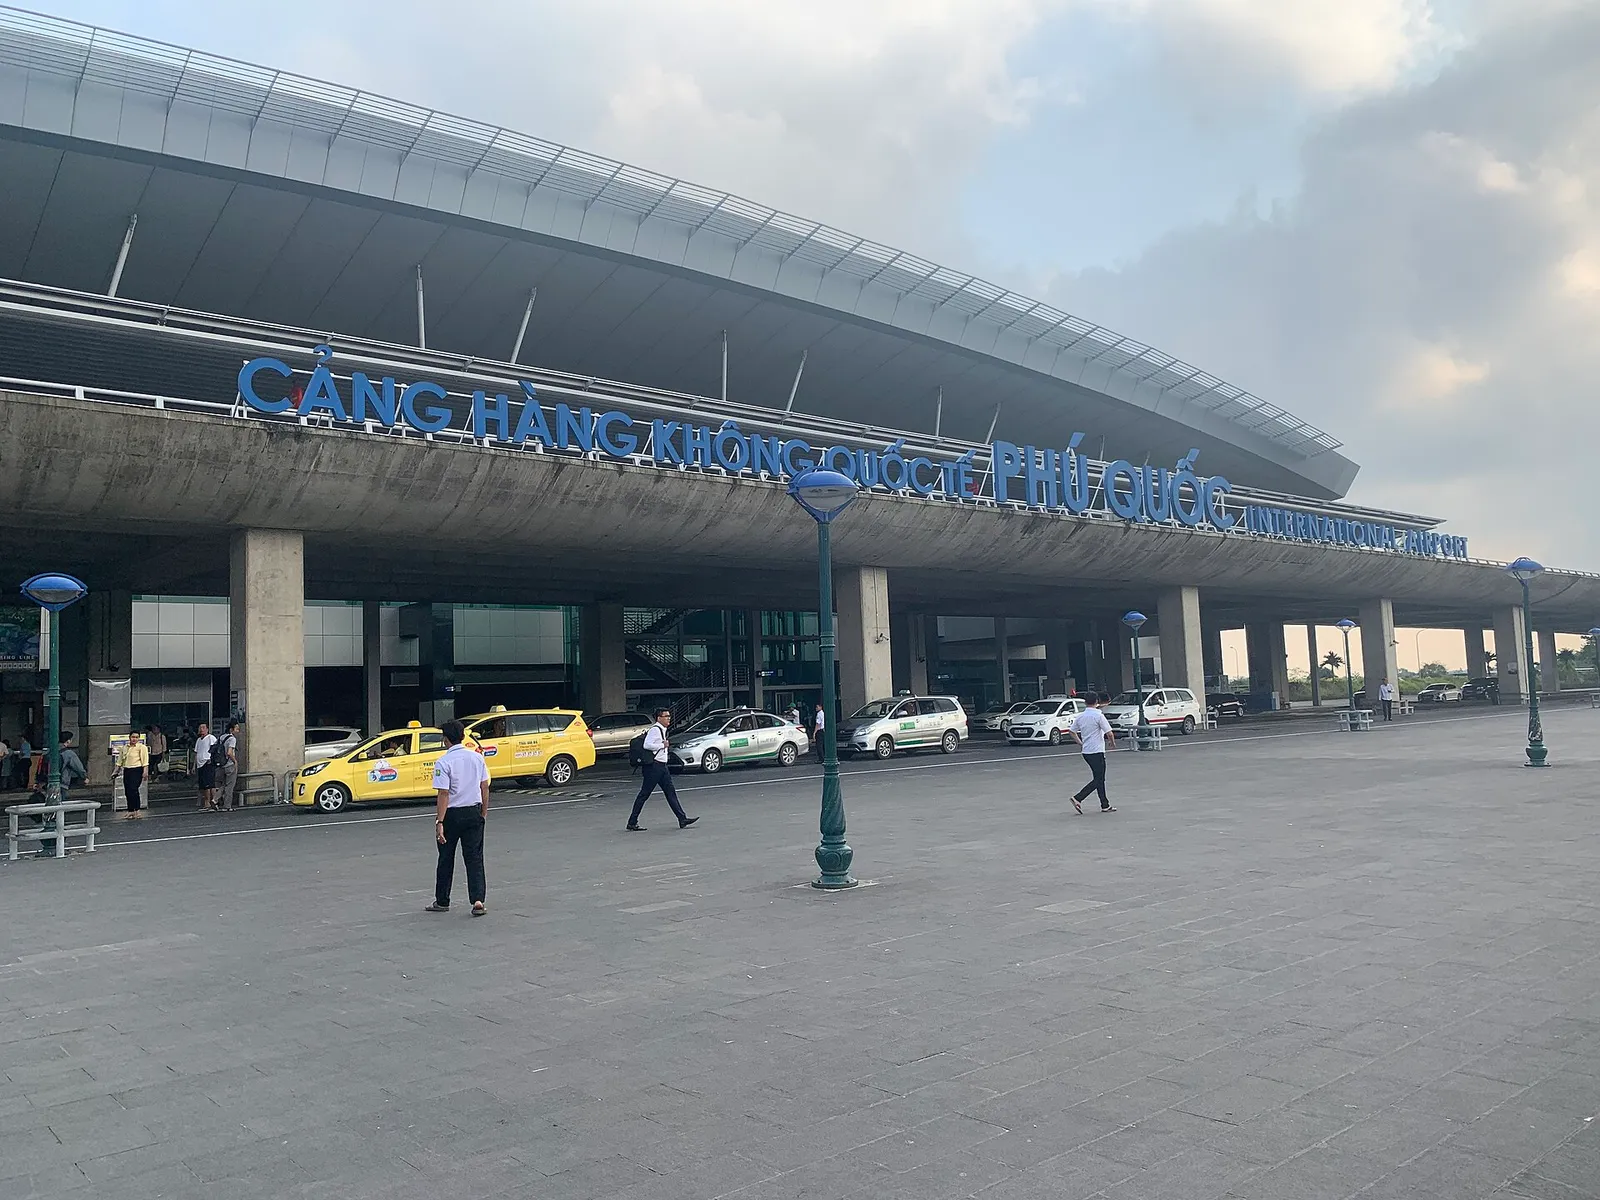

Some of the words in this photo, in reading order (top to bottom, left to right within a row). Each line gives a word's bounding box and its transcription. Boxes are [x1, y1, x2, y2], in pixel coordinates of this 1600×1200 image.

[238, 344, 453, 433] CẢNG
[473, 380, 638, 458] HÀNG
[652, 419, 815, 477] KHÔNG
[824, 438, 934, 494] QUỐC
[941, 449, 976, 498] TẾ
[993, 432, 1089, 514] PHÚ
[1104, 448, 1235, 530] QUỐC
[1247, 505, 1398, 550] INTERNATIONAL
[1404, 529, 1469, 559] AIRPORT
